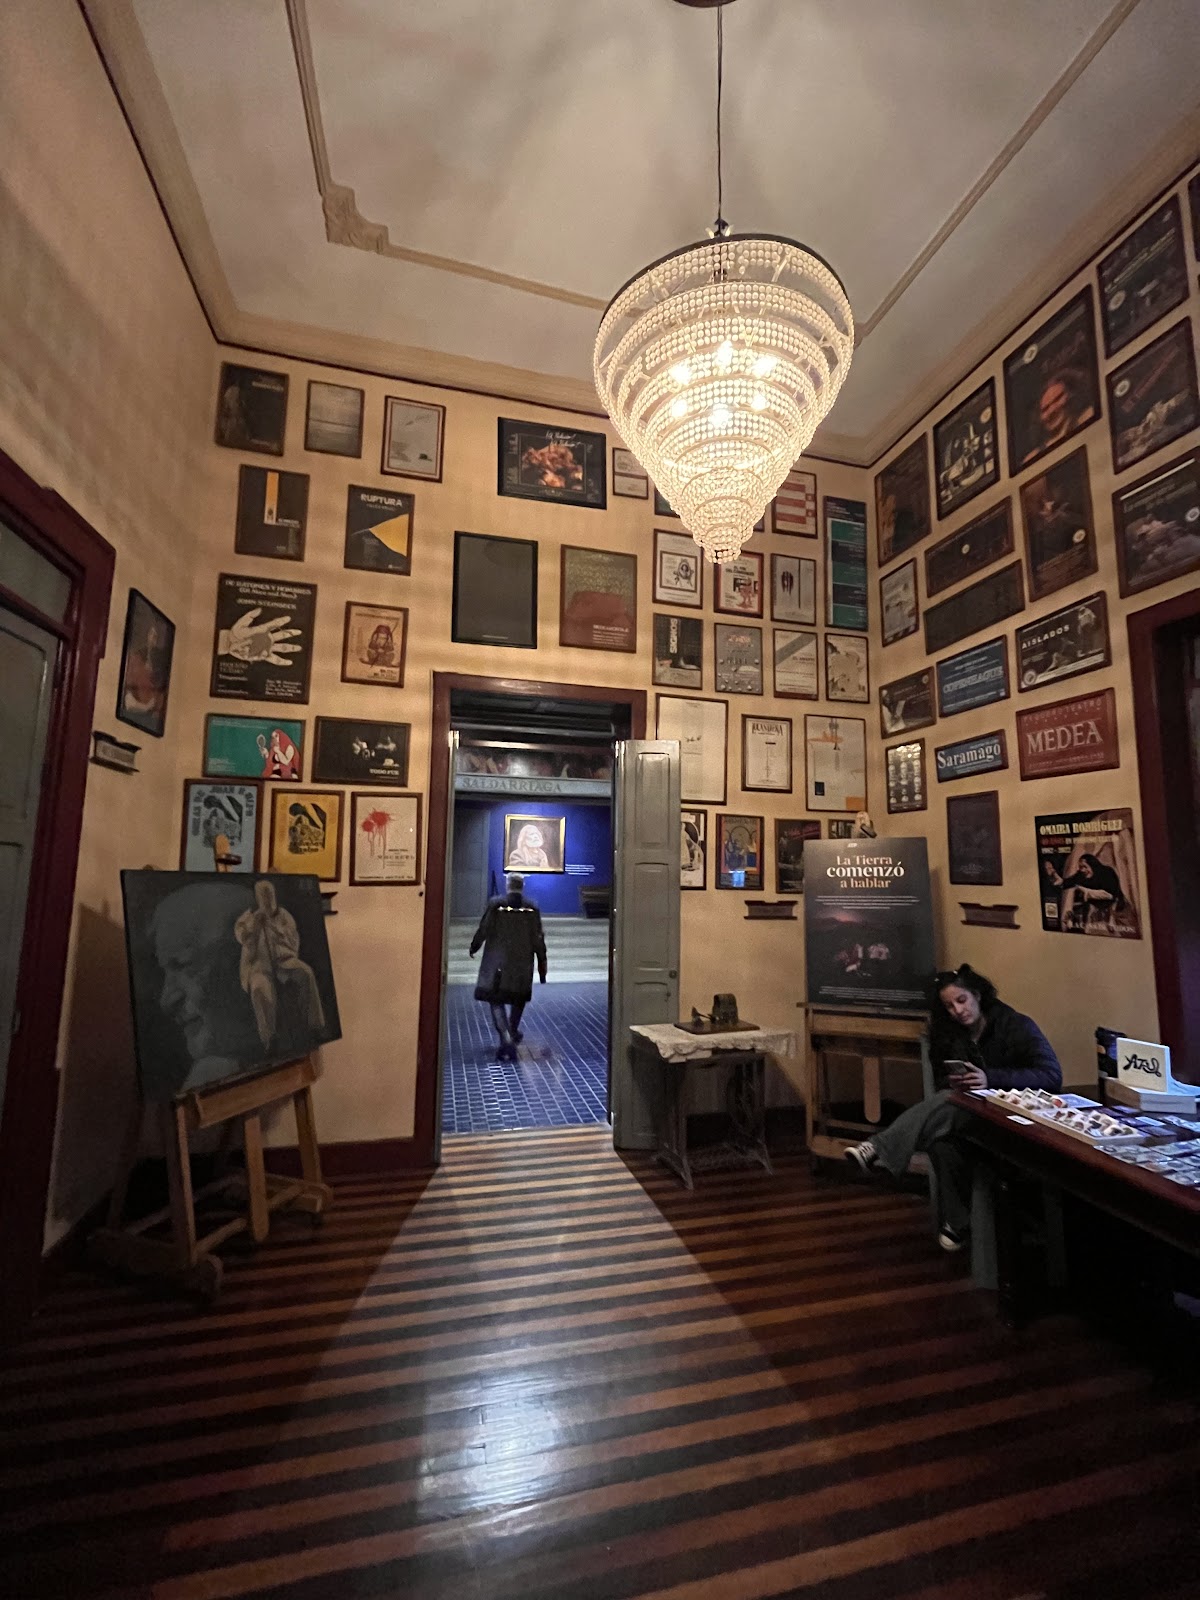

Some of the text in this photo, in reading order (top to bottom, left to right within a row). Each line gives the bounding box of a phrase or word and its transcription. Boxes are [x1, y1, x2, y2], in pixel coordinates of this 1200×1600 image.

[360, 493, 402, 506] RUPTURA
[1021, 624, 1070, 650] AISLADOS
[1026, 720, 1103, 754] MEDEA
[937, 743, 1001, 769] Saramago
[462, 777, 562, 793] SALDARRIAGA
[837, 855, 892, 865] La Tierra
[826, 861, 905, 877] comenzó
[840, 878, 891, 888] a hablar
